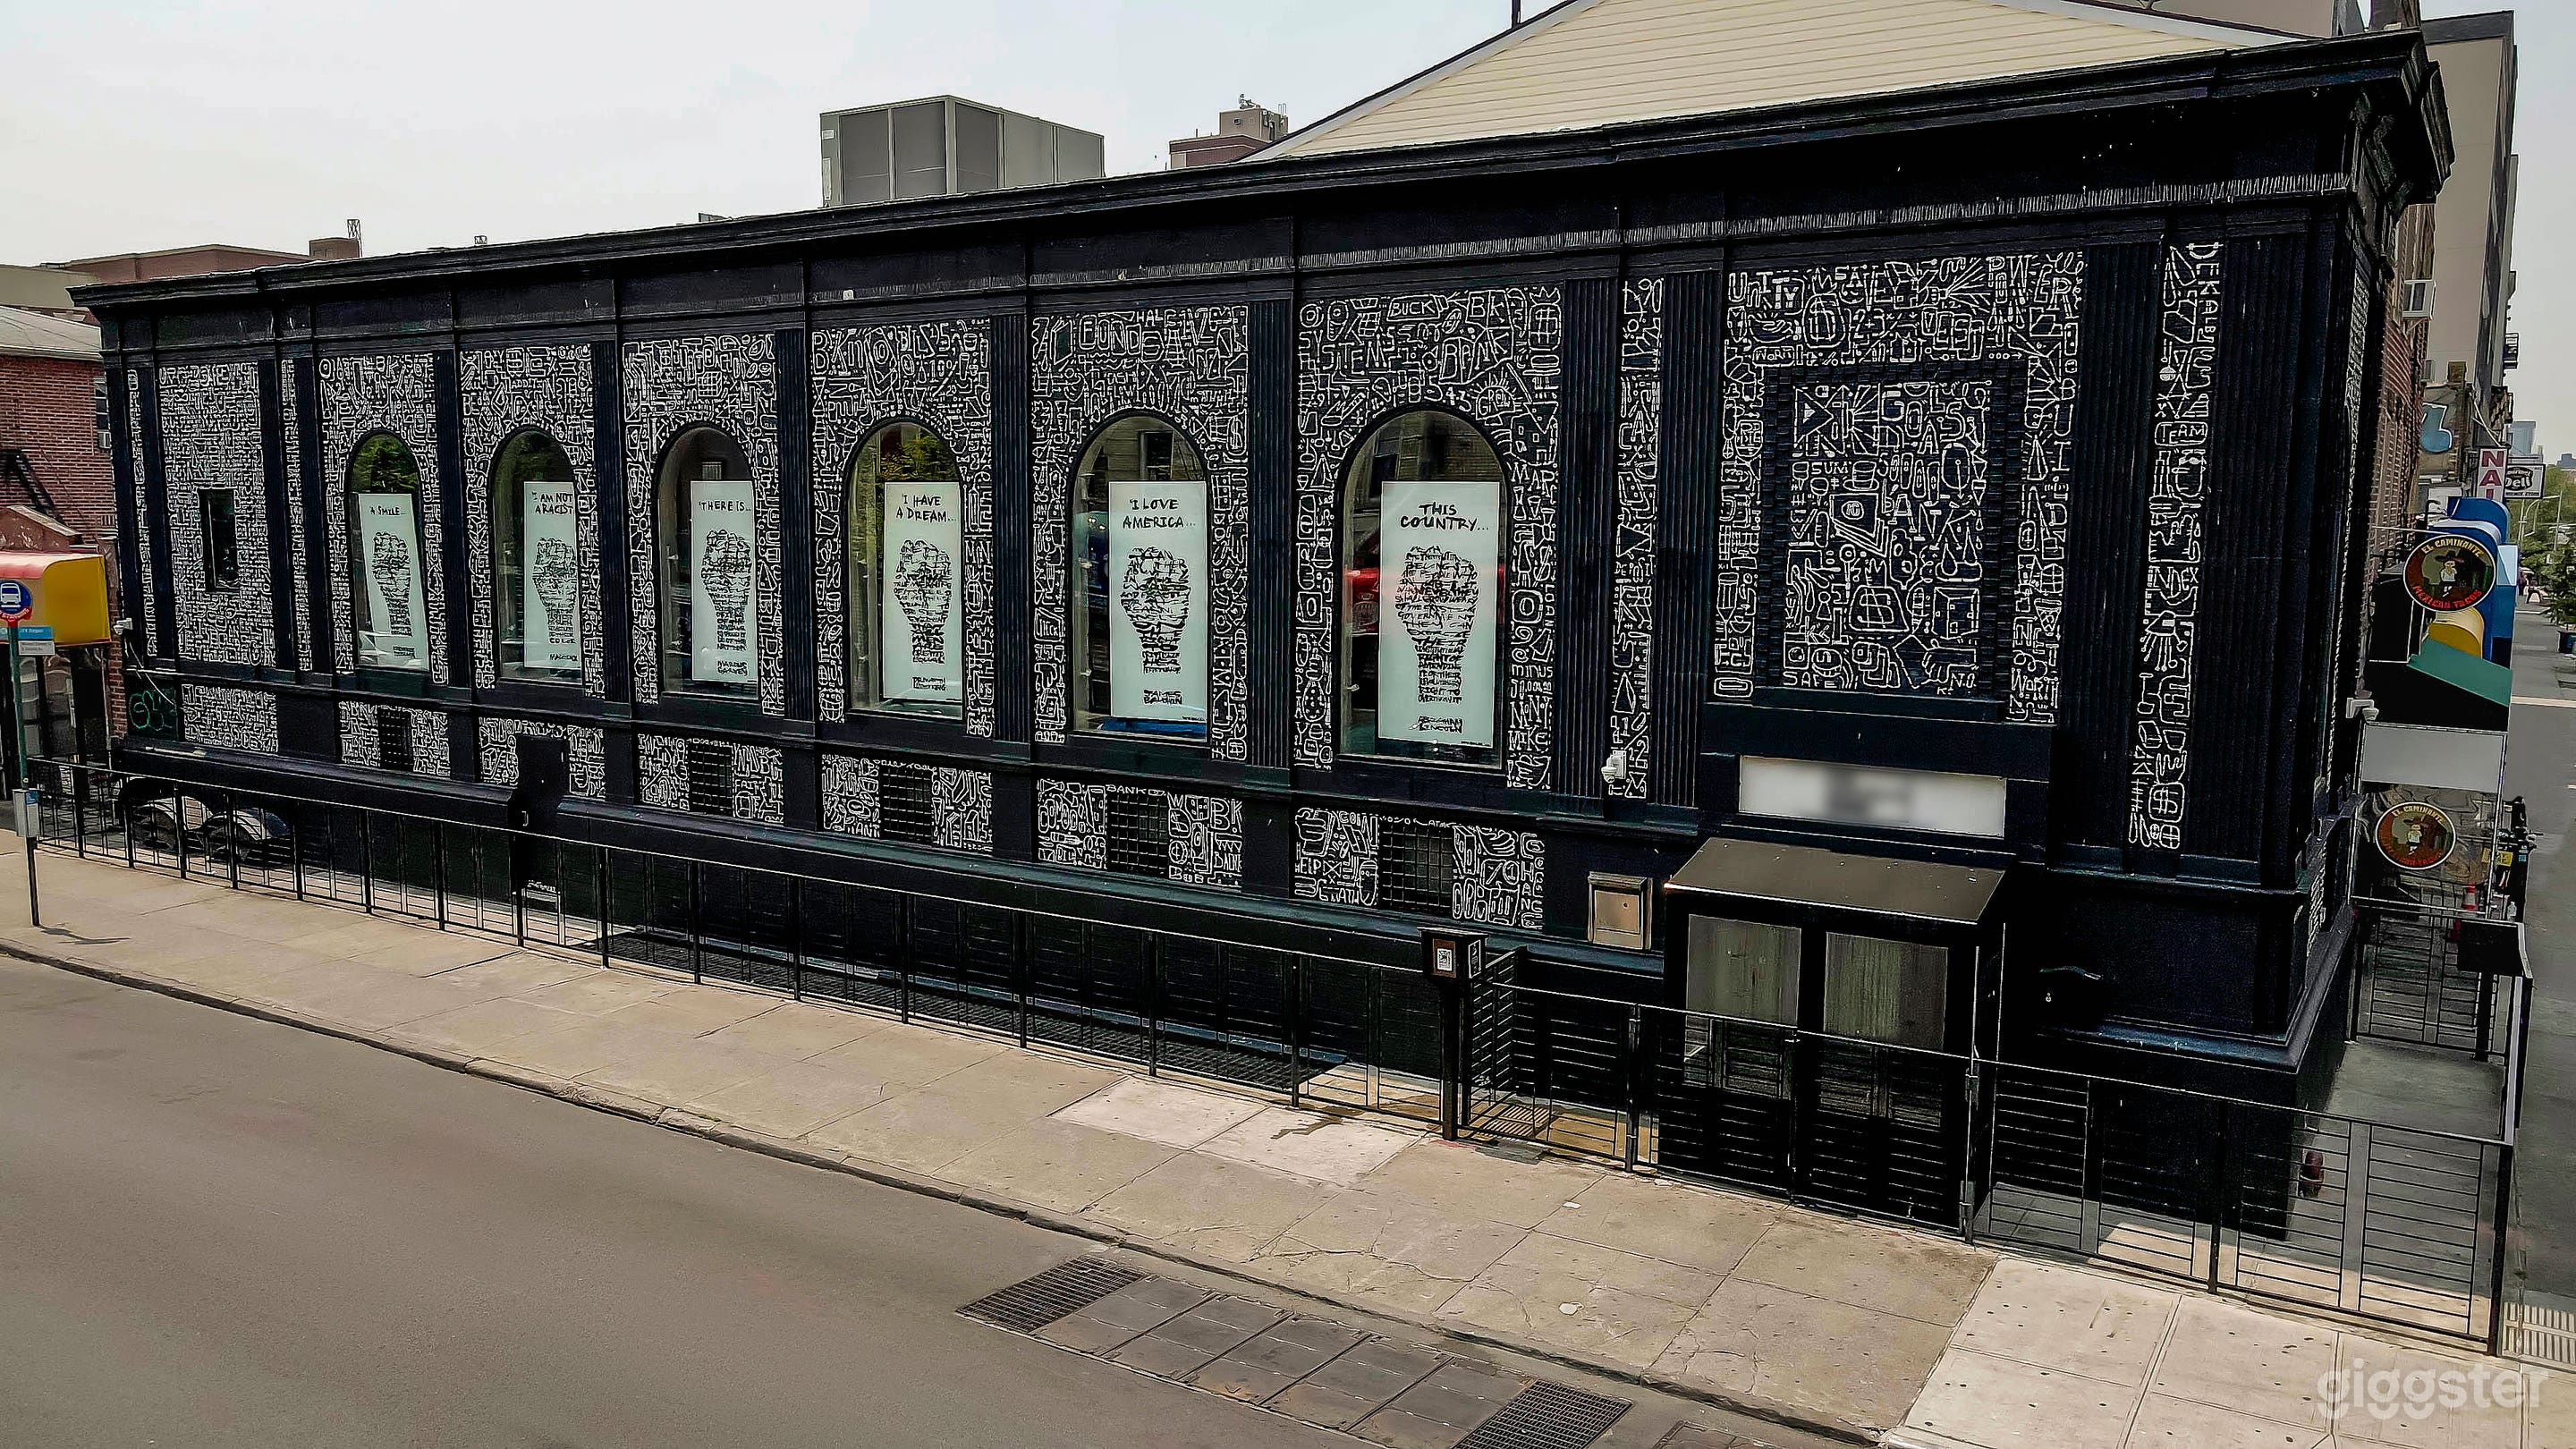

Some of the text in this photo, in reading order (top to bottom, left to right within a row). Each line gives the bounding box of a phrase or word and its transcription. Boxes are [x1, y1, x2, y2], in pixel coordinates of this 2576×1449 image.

[913, 495, 942, 507] HAVE
[1143, 498, 1179, 510] LOVE
[896, 506, 903, 519] A
[1419, 502, 1457, 515] THIS
[2421, 538, 2484, 557] EL CAMINANTE
[1106, 784, 1147, 796] BANK
